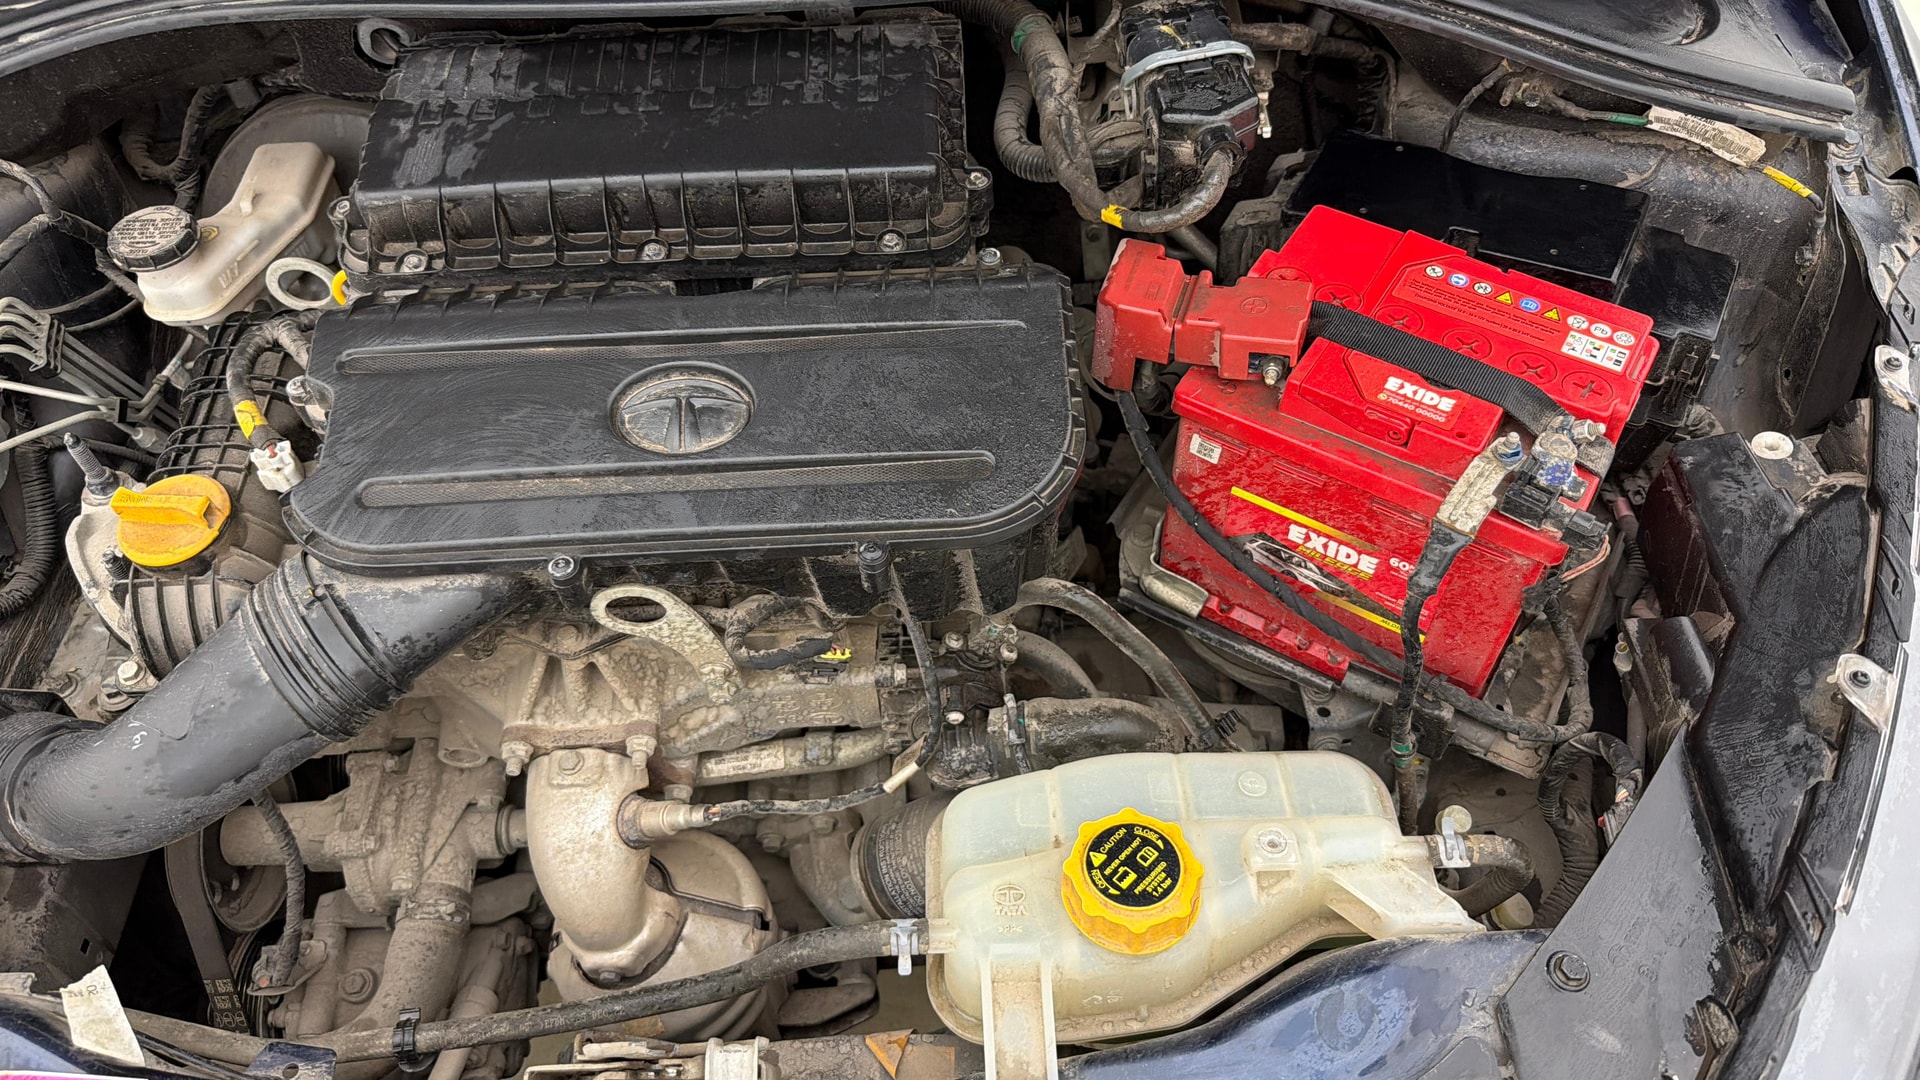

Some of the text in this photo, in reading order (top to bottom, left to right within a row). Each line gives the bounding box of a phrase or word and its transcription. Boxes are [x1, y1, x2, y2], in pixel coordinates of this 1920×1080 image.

[1593, 325, 1608, 335] Pb
[1383, 376, 1456, 412] EXIDE
[1386, 396, 1414, 410] 70440
[1415, 406, 1446, 423] 00000
[1286, 522, 1379, 574] EXIDE
[1295, 545, 1373, 581] MILEAGE
[1101, 828, 1127, 853] CAUTION
[1134, 827, 1160, 841] CLOSE
[1103, 836, 1141, 876] NEVER OPEN HOT
[1091, 869, 1105, 889] OPEN
[1133, 860, 1167, 894] PRESSURISED
[1145, 871, 1166, 892] SYSTEM
[1151, 876, 1172, 897] 1.4 bar
[993, 905, 1027, 915] TATA
